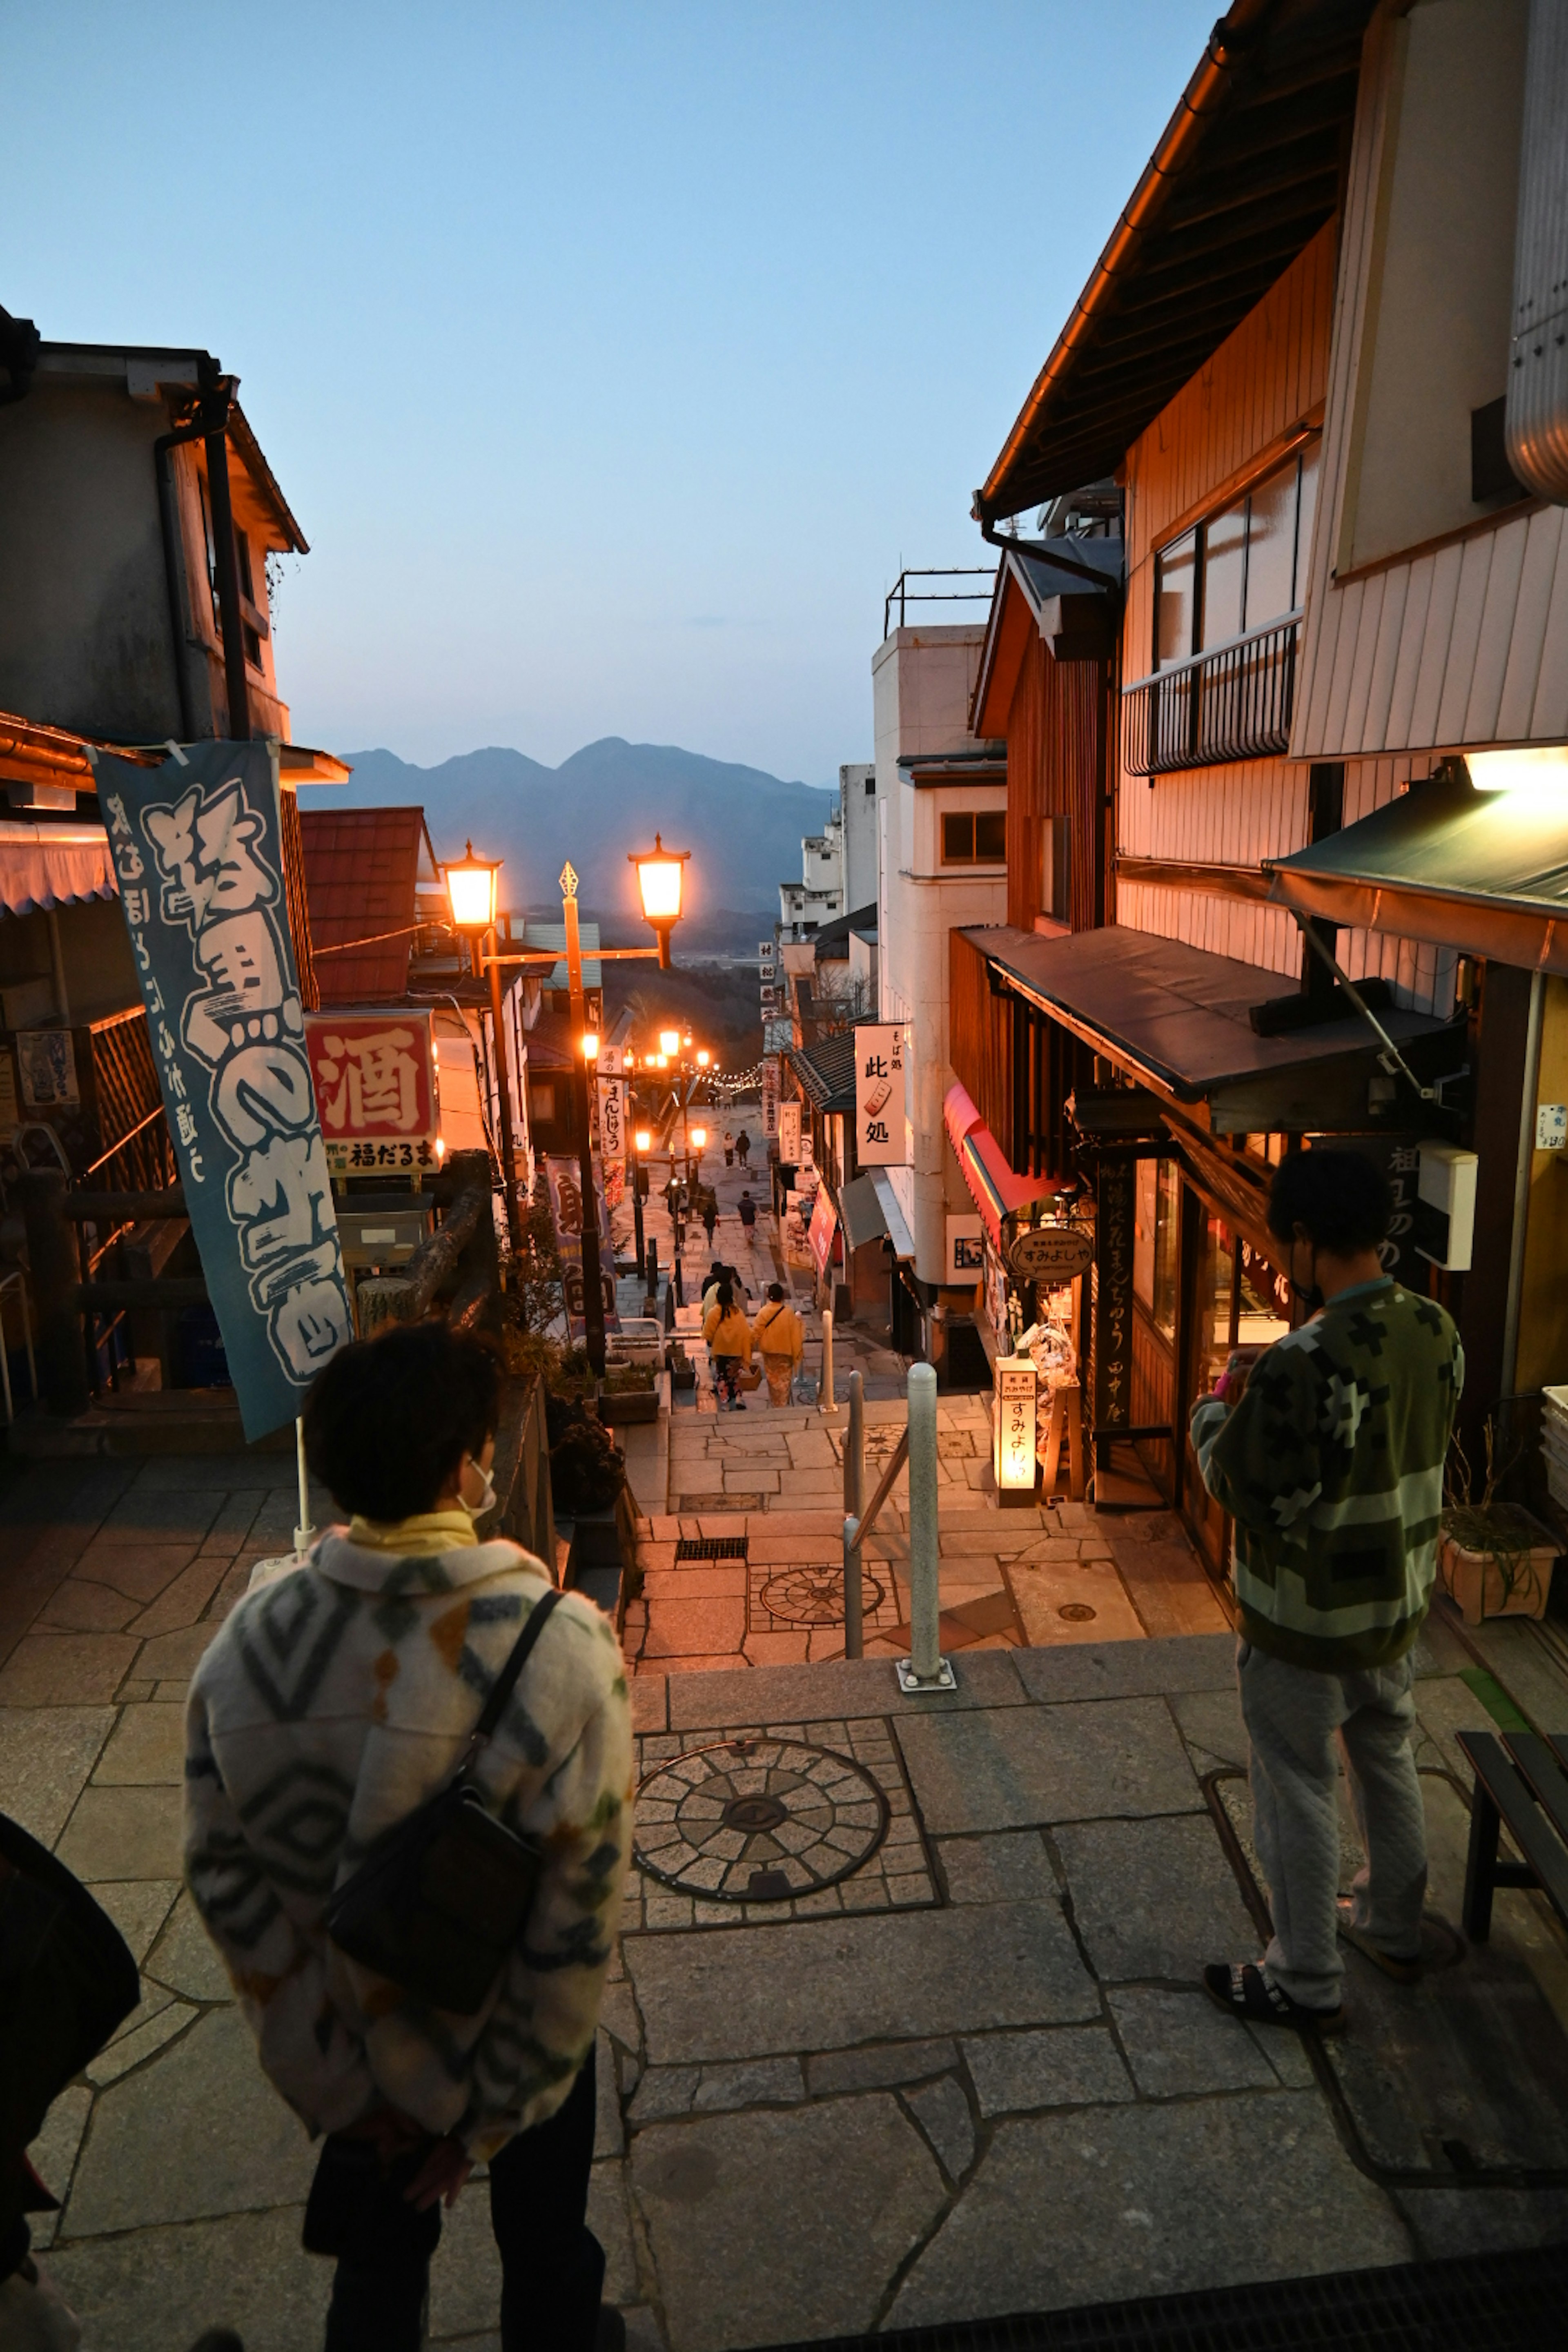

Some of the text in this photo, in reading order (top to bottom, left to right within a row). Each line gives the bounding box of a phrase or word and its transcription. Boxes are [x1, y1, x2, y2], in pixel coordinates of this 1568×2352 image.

[891, 1031, 901, 1070] そば処
[317, 1027, 419, 1129] 酒
[349, 1140, 433, 1166] 福だるま
[1024, 1249, 1089, 1262] すみよしや
[1106, 1361, 1125, 1422] 田中屋
